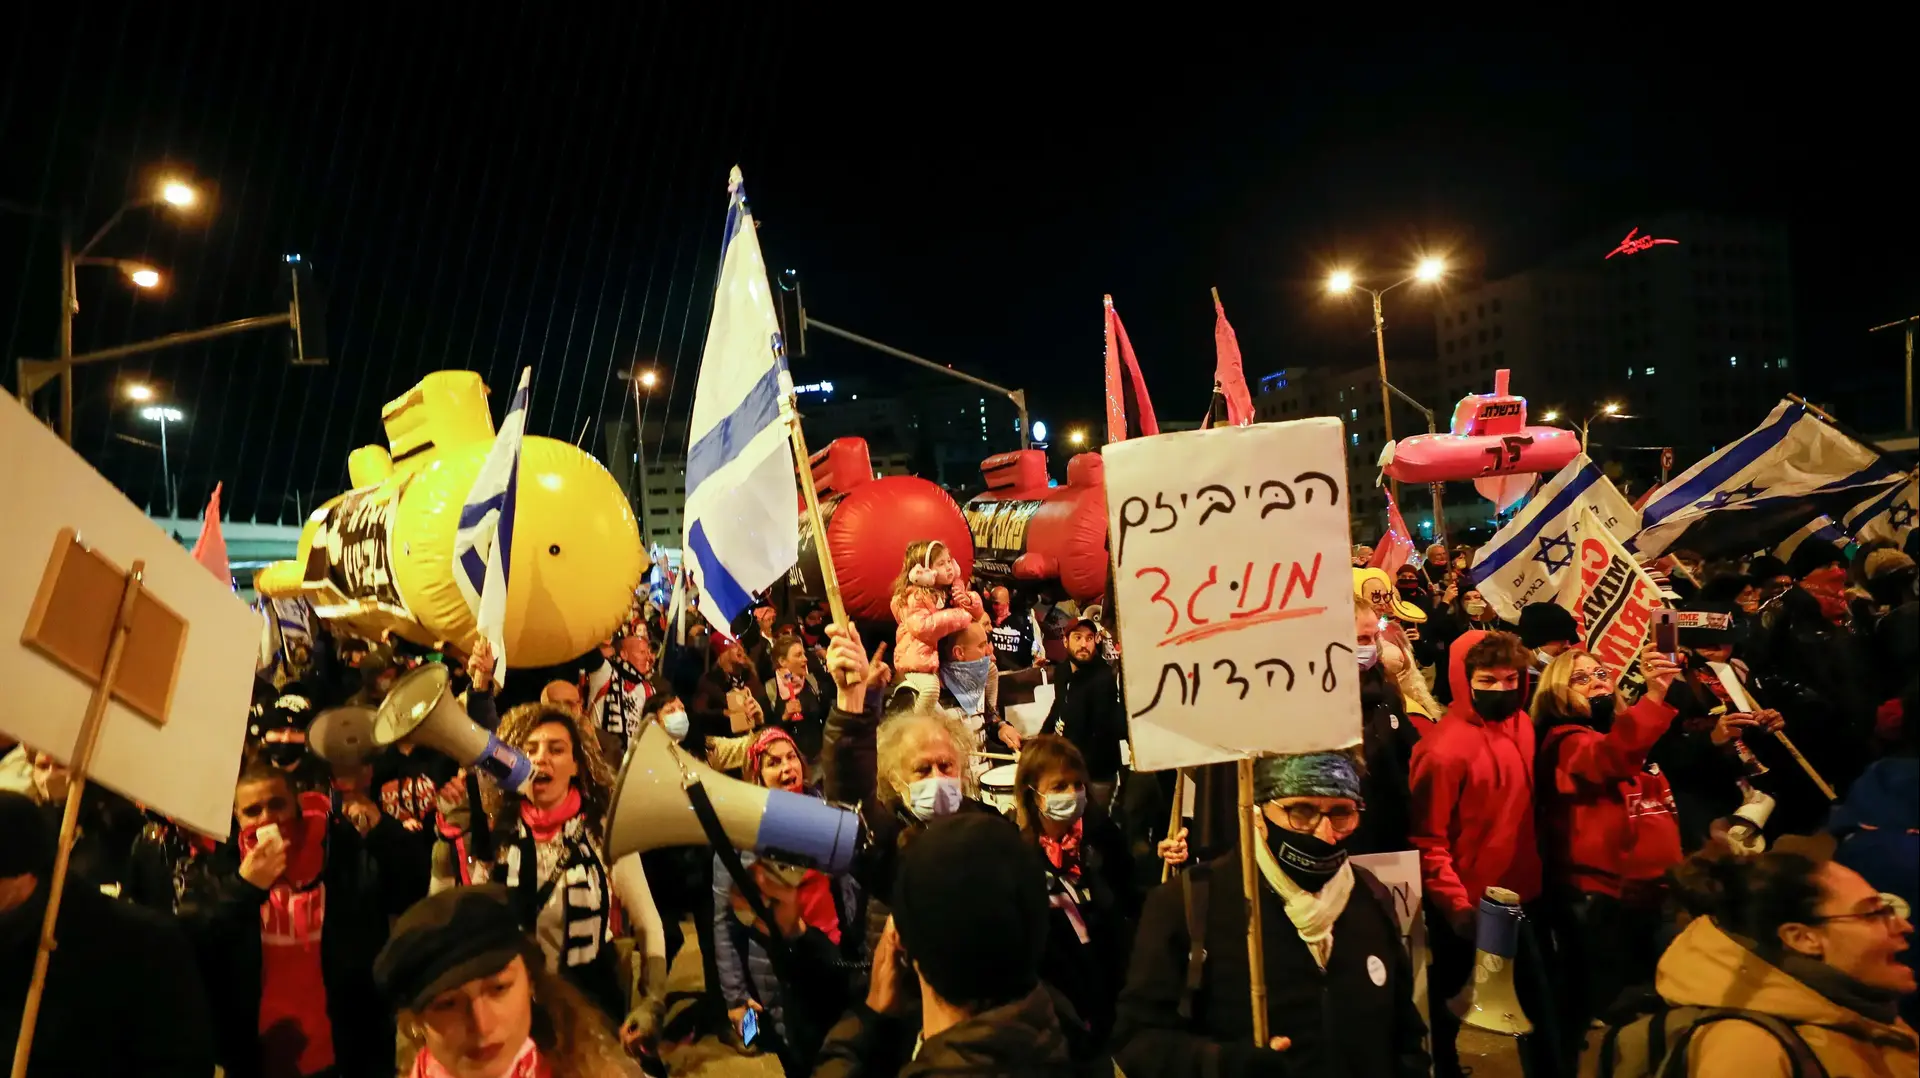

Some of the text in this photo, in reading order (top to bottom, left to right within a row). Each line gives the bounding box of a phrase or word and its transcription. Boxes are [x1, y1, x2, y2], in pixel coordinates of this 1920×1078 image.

[1117, 471, 1339, 568] הביביזם
[1135, 552, 1322, 635] מנוגד
[1512, 571, 1526, 588] עם
[1512, 578, 1545, 611] בארצנו
[994, 643, 1018, 653] עכשי
[1131, 641, 1353, 719] ליהדות
